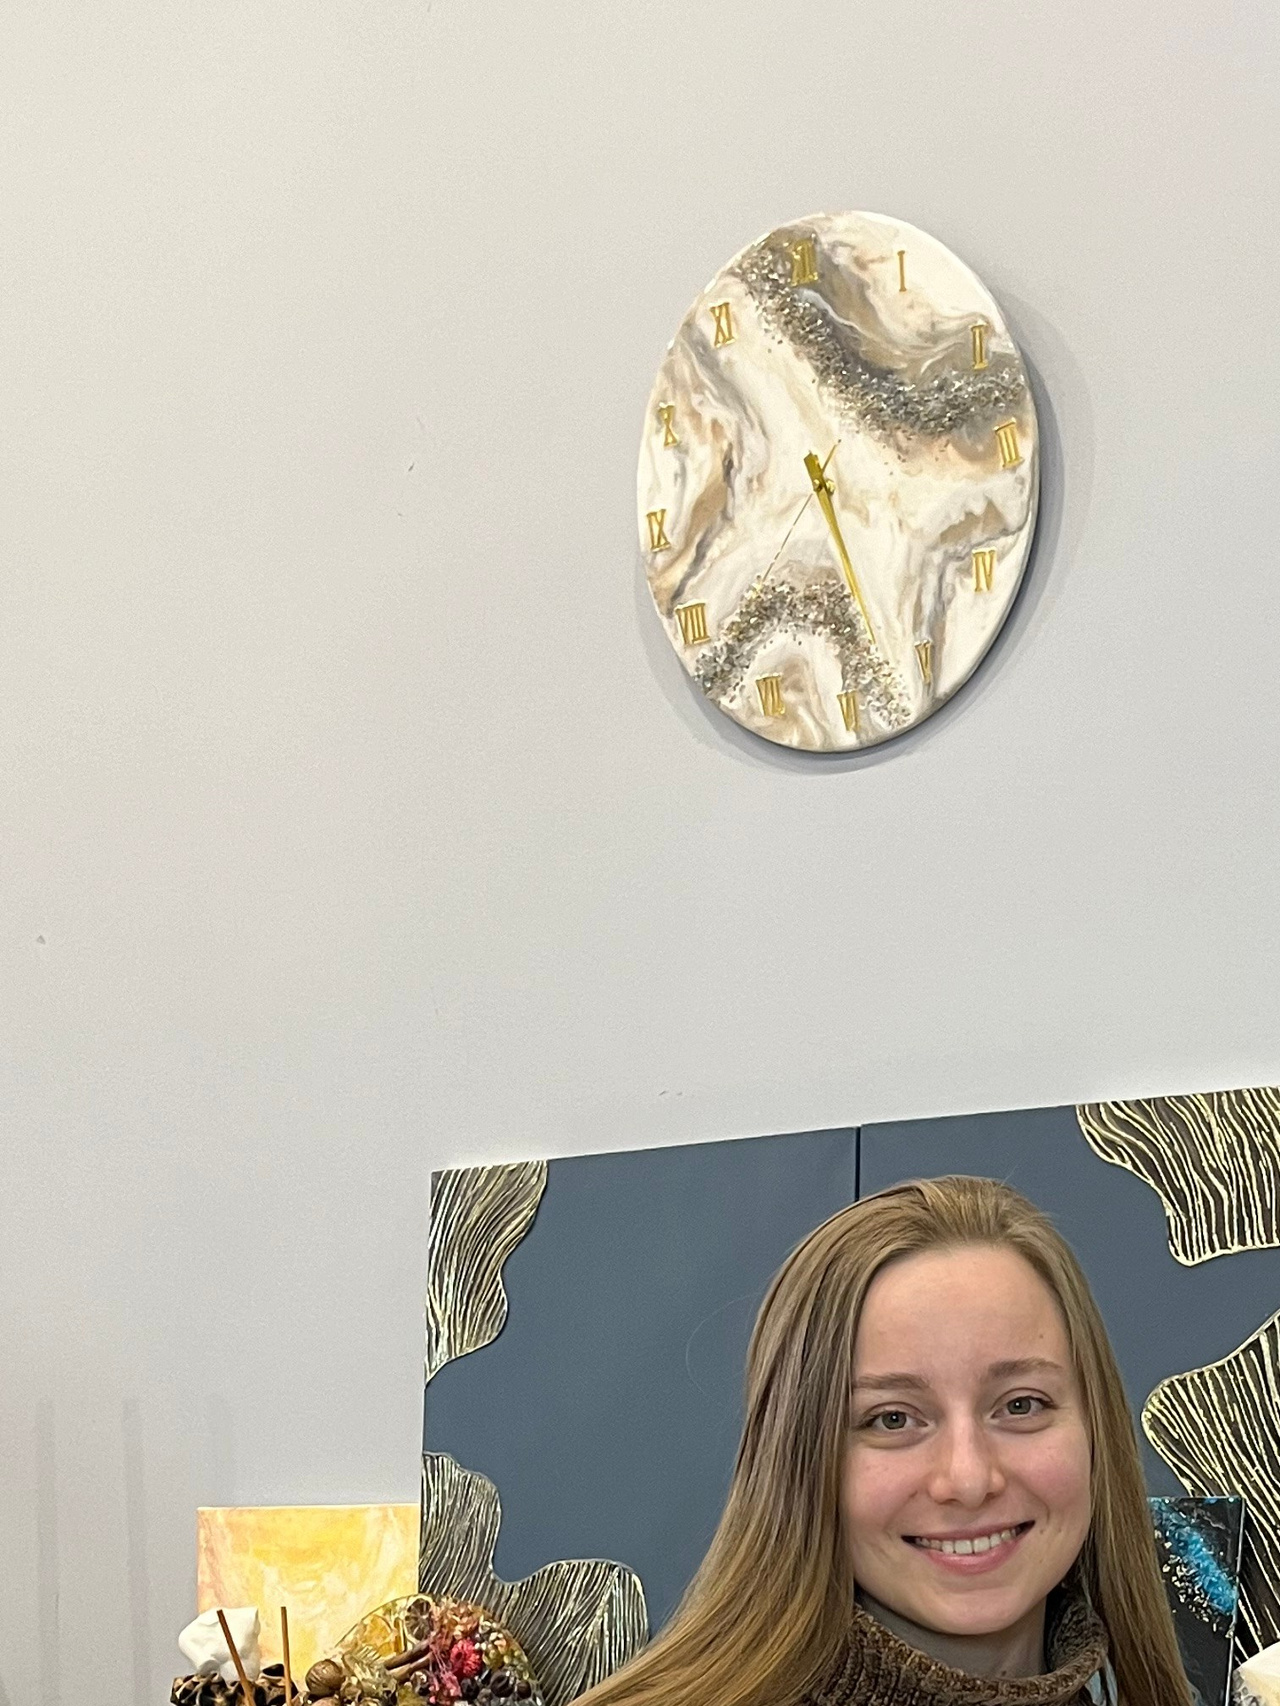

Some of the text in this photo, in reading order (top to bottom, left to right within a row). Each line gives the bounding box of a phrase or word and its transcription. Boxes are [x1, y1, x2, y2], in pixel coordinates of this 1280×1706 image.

[897, 250, 907, 292] I
[709, 302, 736, 347] XI
[971, 324, 988, 369] II
[657, 404, 678, 447] X
[994, 421, 1024, 468] III
[646, 508, 671, 551] IX
[973, 549, 996, 592] IV
[675, 603, 710, 645] VIII
[914, 640, 932, 685] V
[755, 675, 785, 717] VII
[836, 690, 860, 732] VI
